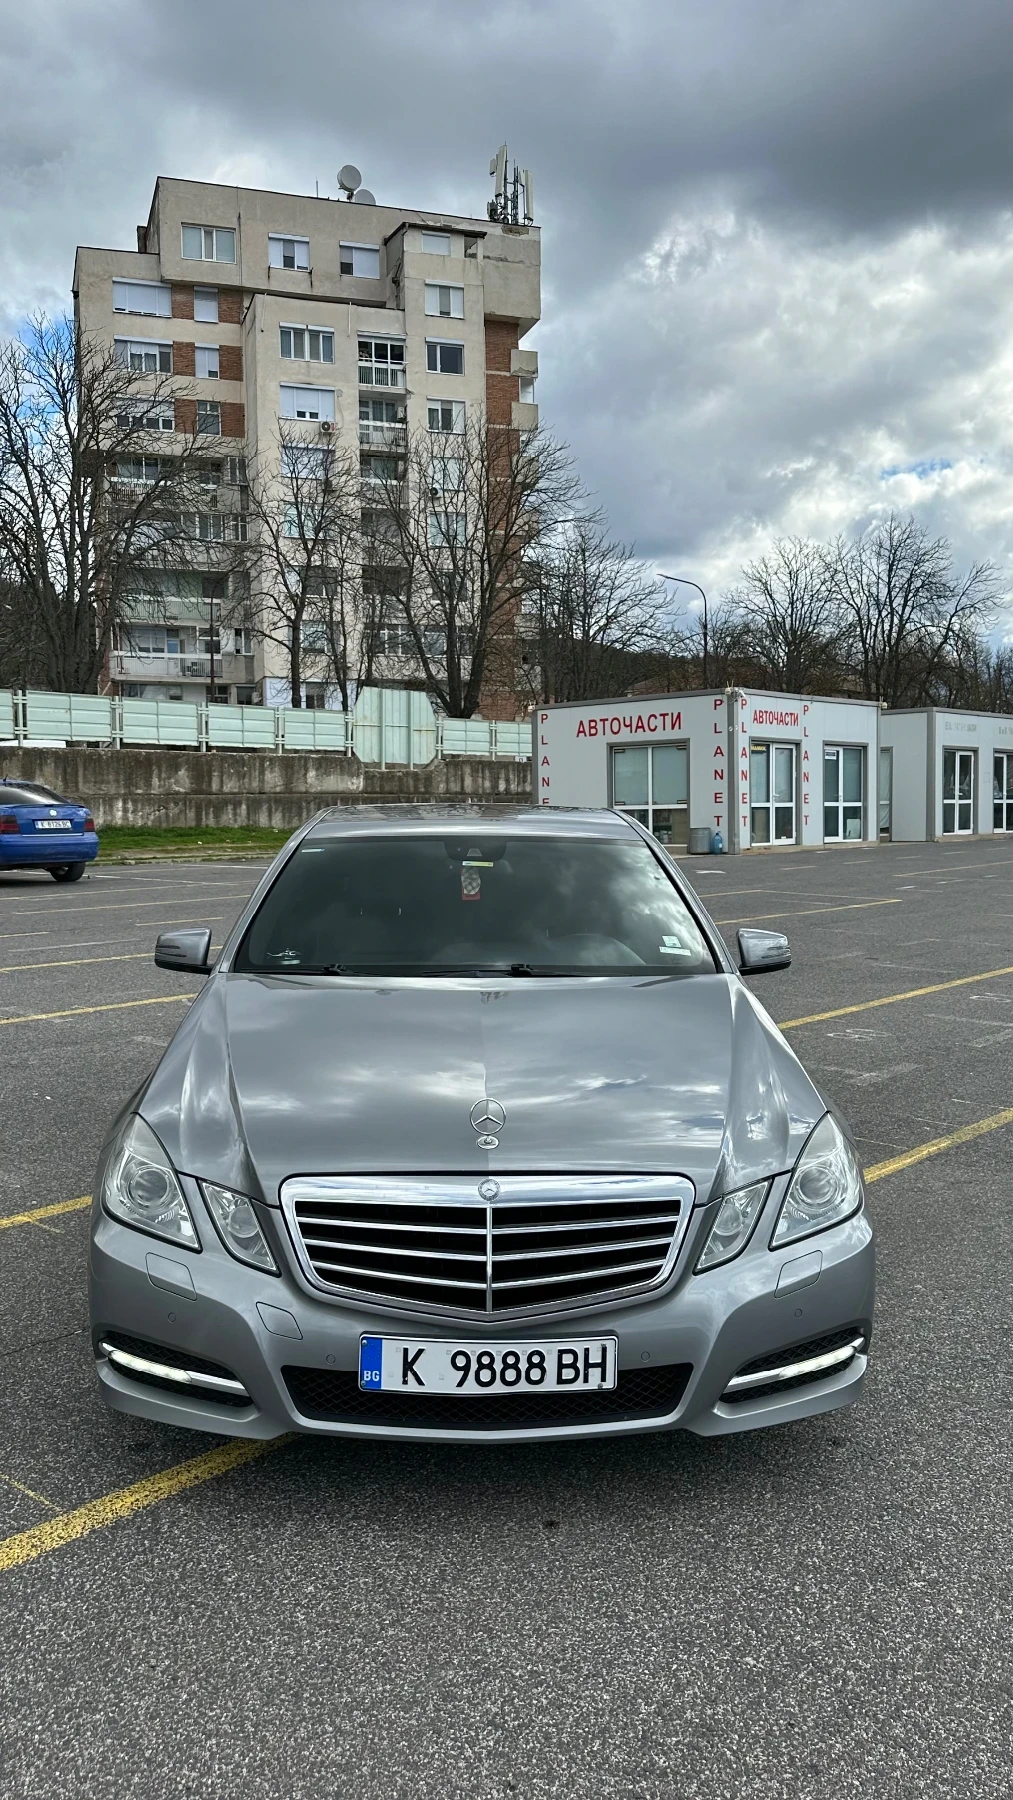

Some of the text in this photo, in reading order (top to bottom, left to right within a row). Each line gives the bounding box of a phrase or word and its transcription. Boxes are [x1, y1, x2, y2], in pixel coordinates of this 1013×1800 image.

[576, 712, 682, 738] АВТОЧАСТИ
[753, 710, 798, 727] АВТОЧАСТИ
[714, 699, 724, 827] PLANET
[363, 1370, 380, 1382] BG
[402, 1345, 607, 1388] K 9888 BH
